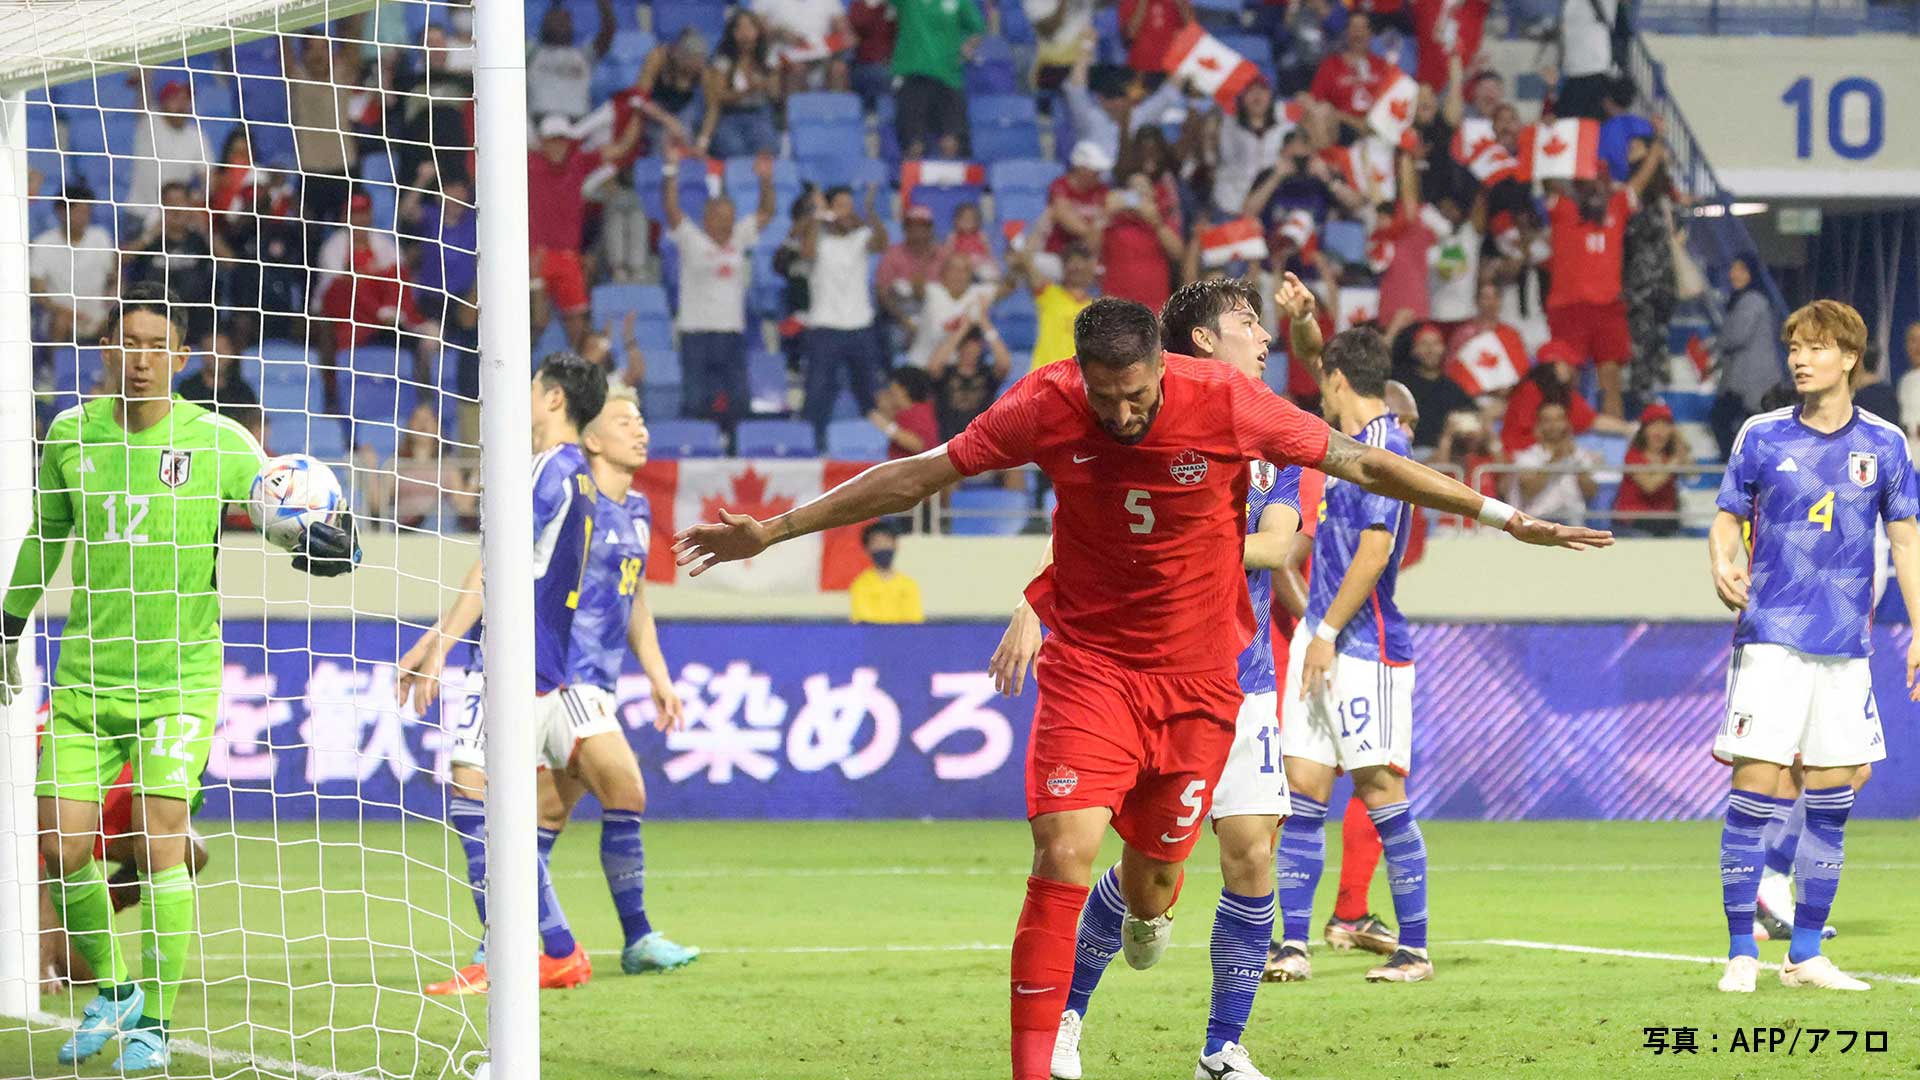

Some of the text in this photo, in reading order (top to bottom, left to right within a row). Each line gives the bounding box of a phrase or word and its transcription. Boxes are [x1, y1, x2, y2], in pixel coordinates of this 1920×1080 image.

[1781, 76, 1885, 160] 10
[1171, 464, 1207, 474] CANADA
[102, 494, 150, 543] 12
[1124, 489, 1155, 534] 5
[1808, 491, 1835, 532] 4
[618, 557, 642, 596] 18
[150, 714, 201, 762] 12
[1338, 696, 1371, 737] 19
[1176, 779, 1207, 827] 5
